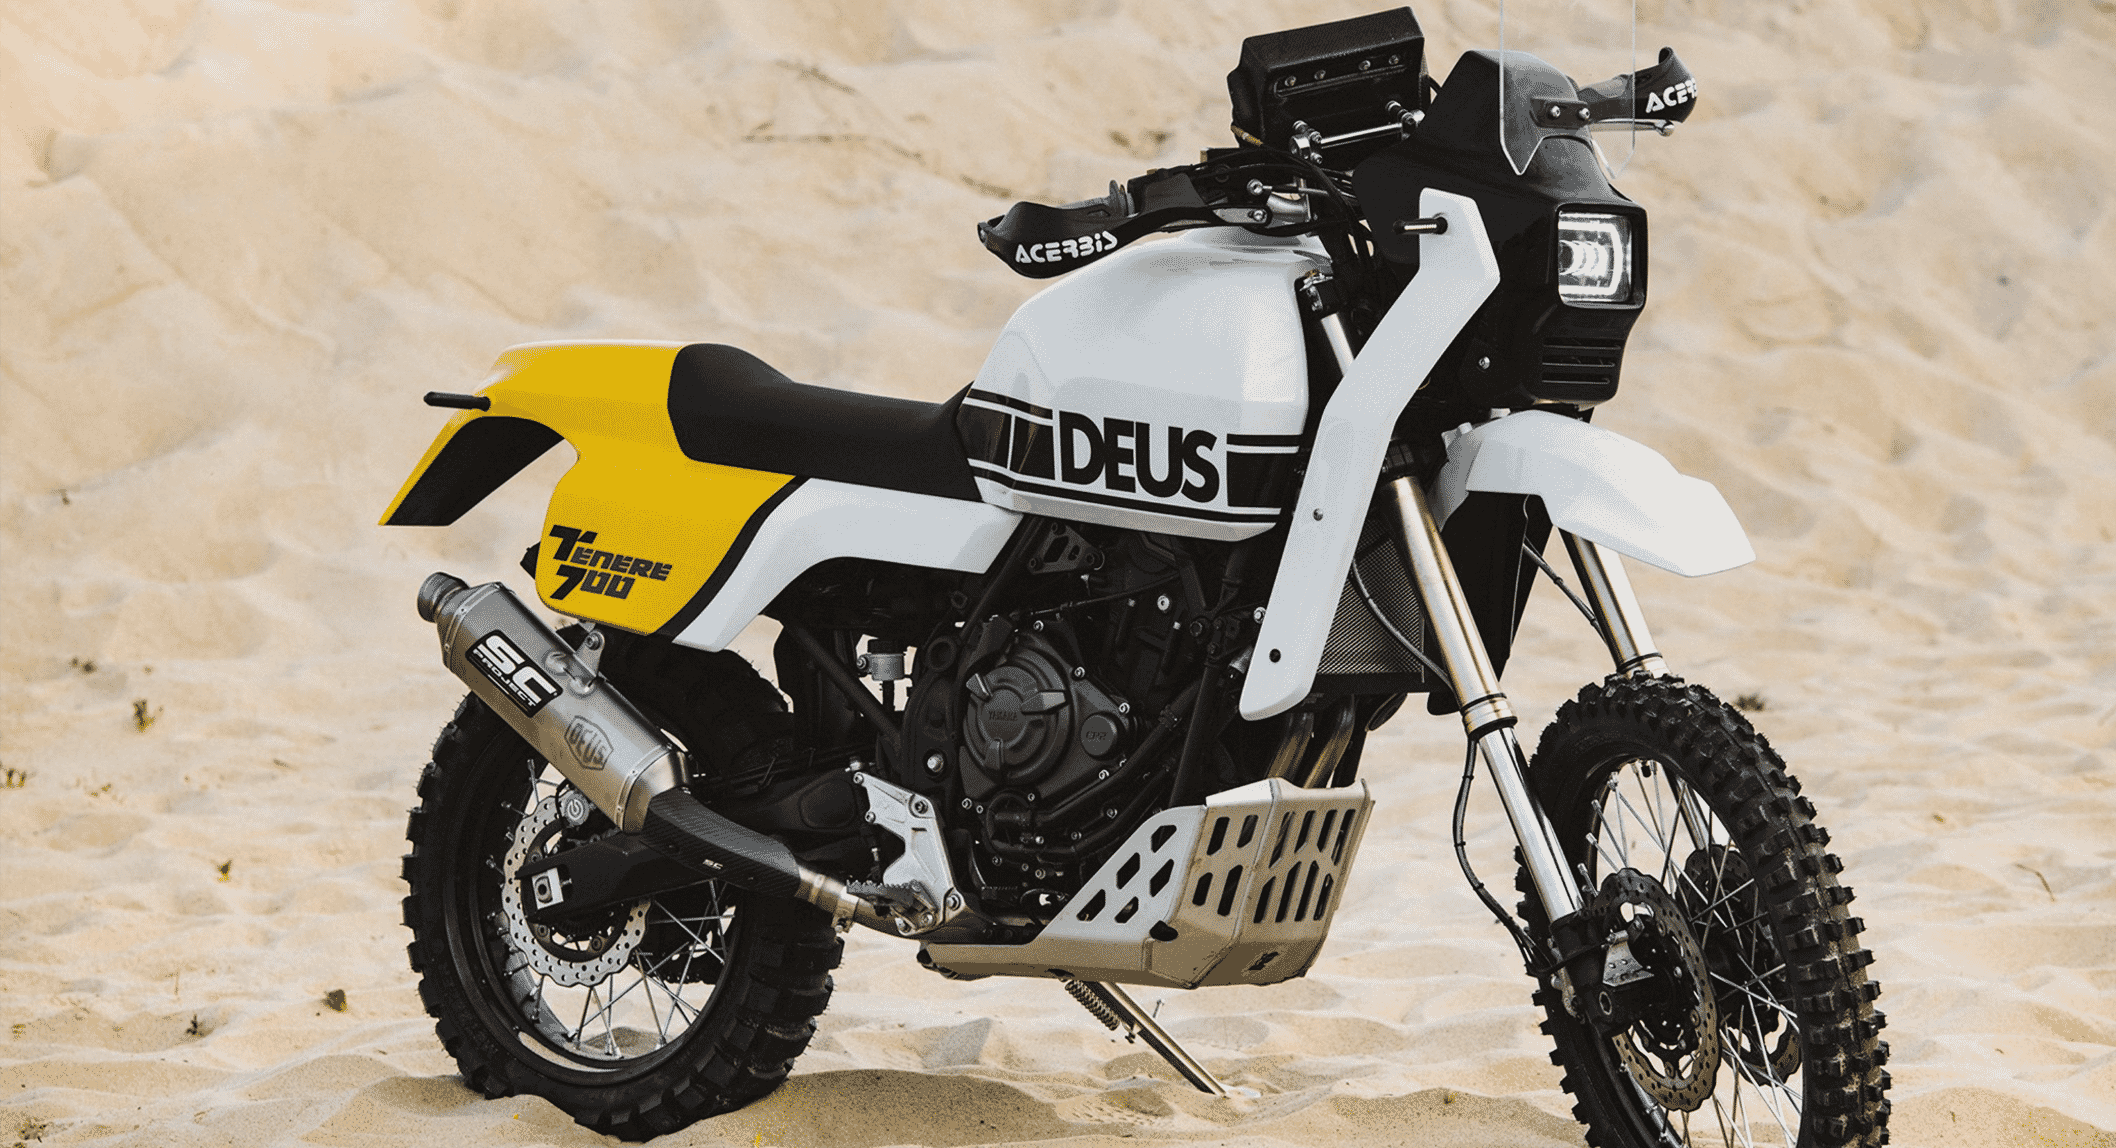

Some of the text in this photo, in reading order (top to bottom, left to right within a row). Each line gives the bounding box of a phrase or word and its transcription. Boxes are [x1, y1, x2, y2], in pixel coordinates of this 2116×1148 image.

[1059, 410, 1220, 503] DEUS
[550, 563, 636, 601] 700
[472, 648, 537, 707] PROJECT
[477, 635, 557, 704] SC
[568, 722, 606, 765] DEUS
